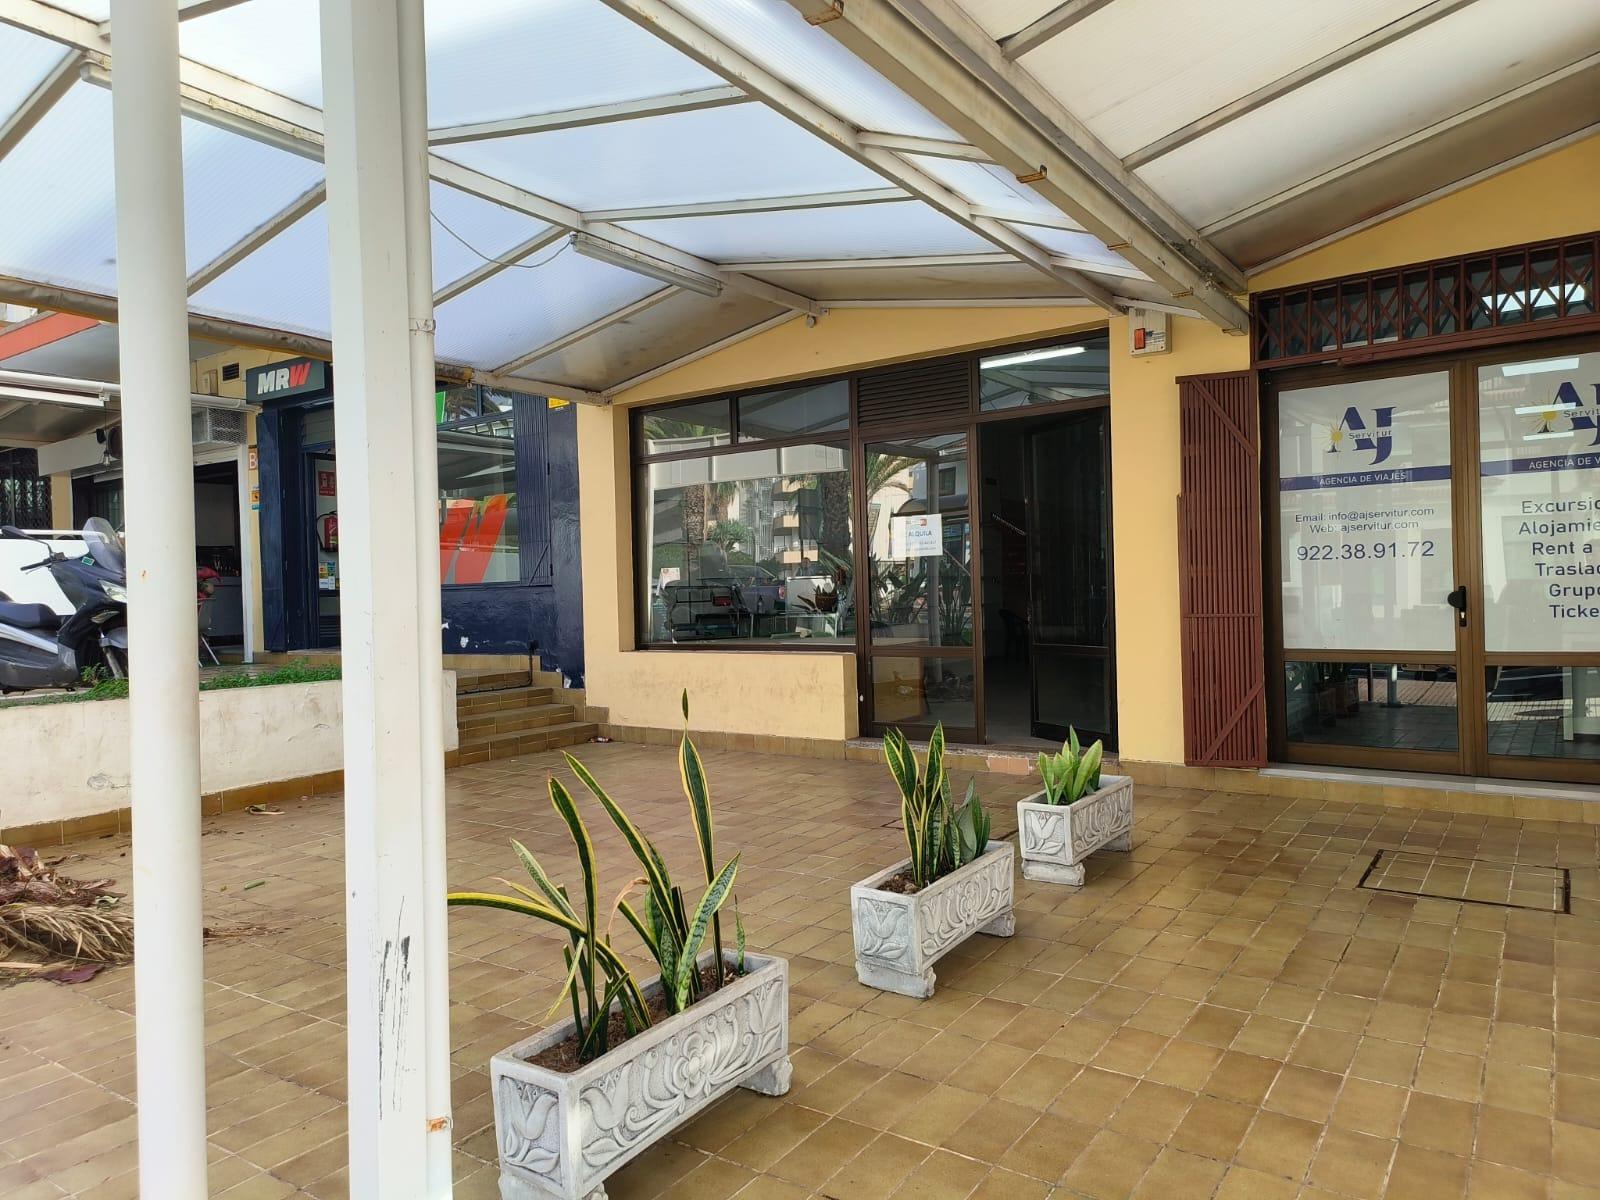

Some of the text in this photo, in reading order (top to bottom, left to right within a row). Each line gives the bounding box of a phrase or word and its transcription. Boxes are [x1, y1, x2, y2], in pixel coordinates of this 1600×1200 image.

[257, 361, 312, 395] MRW
[1327, 406, 1397, 465] AJ
[1348, 430, 1392, 440] Servitur
[1529, 458, 1575, 470] AGENCIA
[1577, 456, 1592, 466] DE
[1319, 472, 1406, 486] AGENCIA DE VIAJES
[1295, 507, 1435, 523] Email: info@ajservitur.com
[1309, 521, 1419, 534] Web: ajservitur.com
[1518, 518, 1600, 537] Alojamie
[1297, 540, 1435, 561] 922.38.91.72
[1532, 541, 1593, 556] Rent a
[1549, 604, 1600, 618] Ticke
